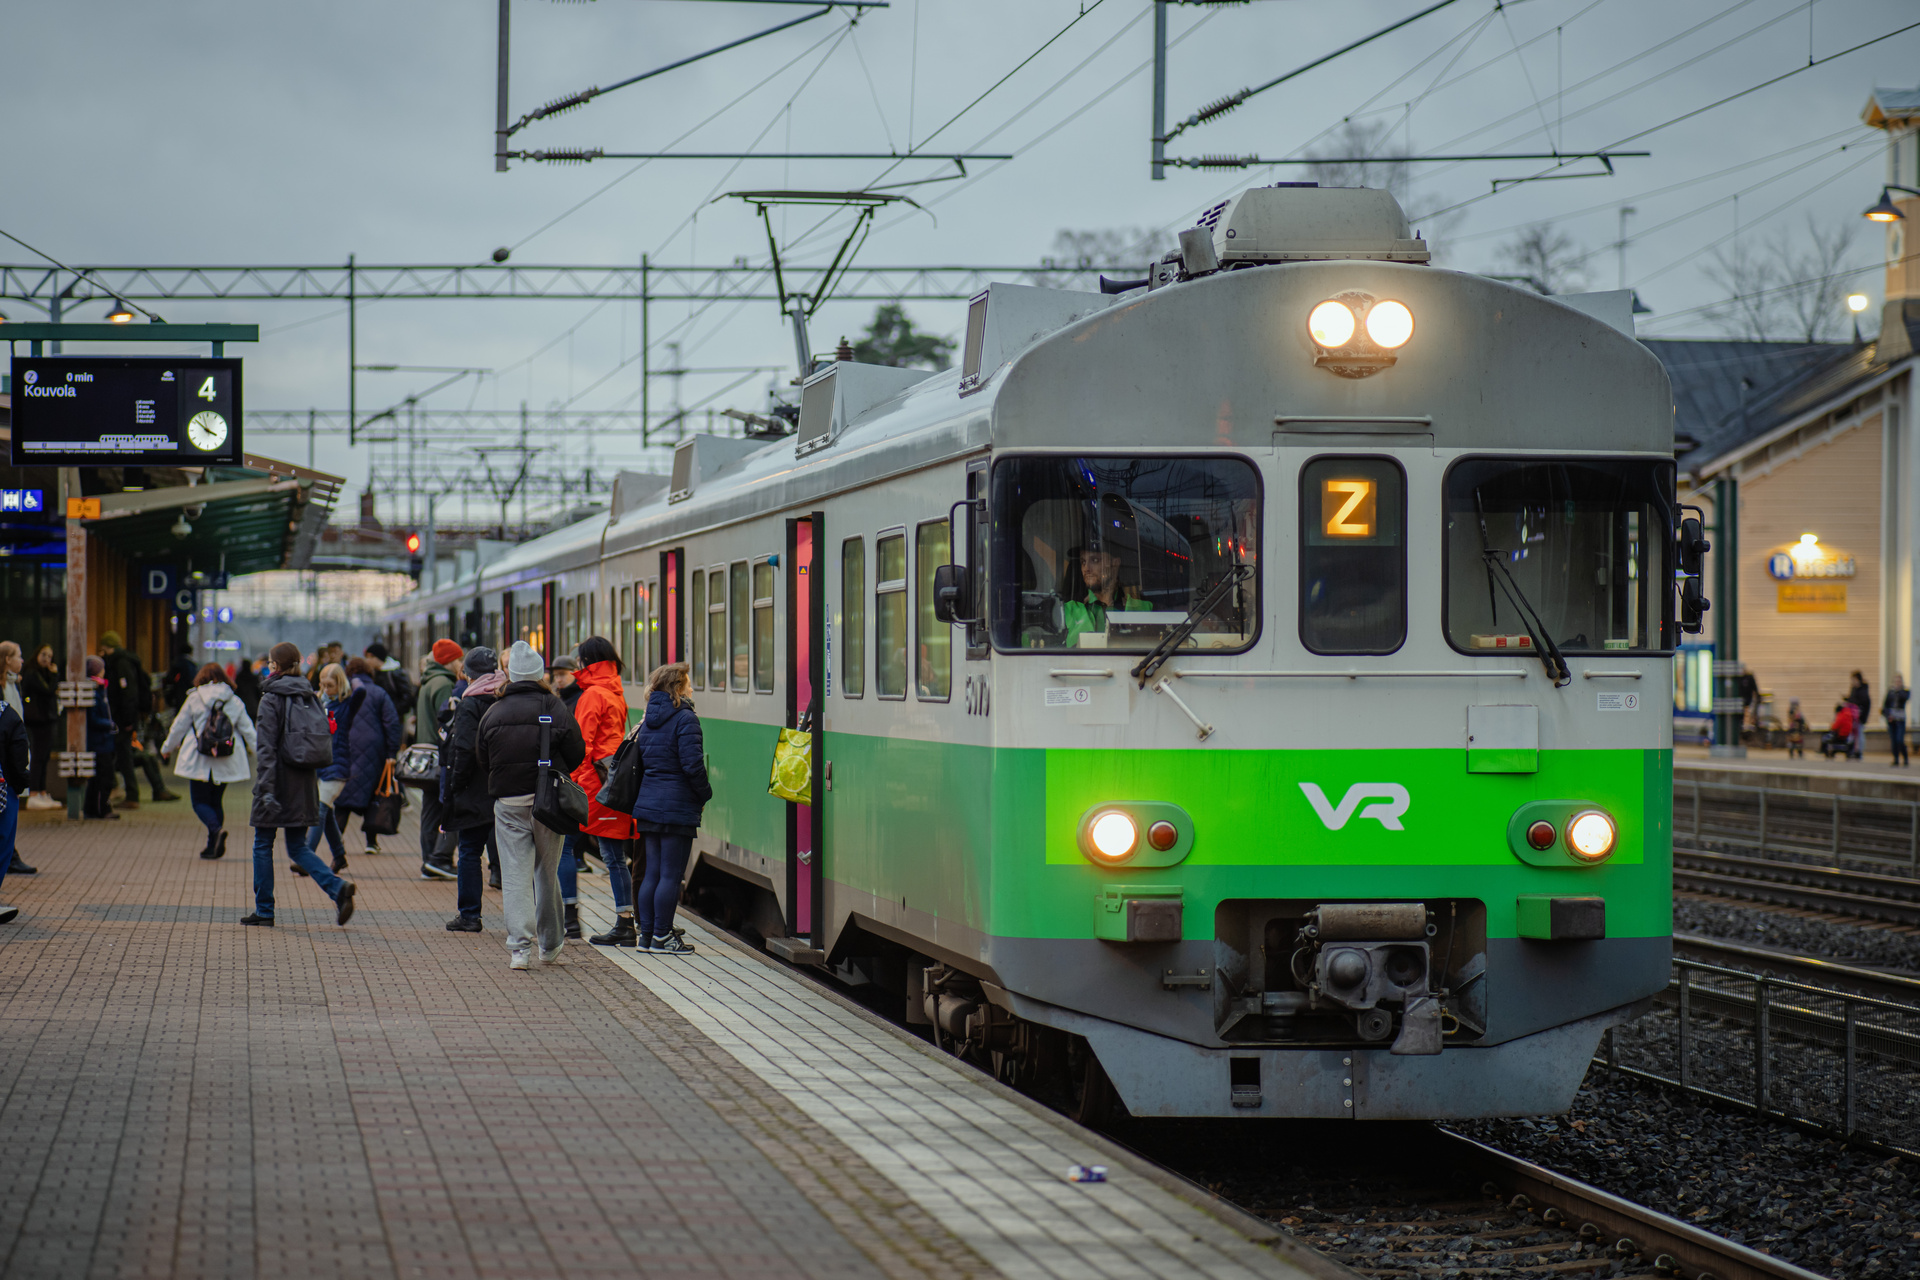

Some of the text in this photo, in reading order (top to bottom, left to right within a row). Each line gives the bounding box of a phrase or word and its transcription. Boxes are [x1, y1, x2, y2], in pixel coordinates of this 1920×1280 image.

[66, 372, 74, 382] 0
[75, 371, 94, 382] min
[24, 384, 77, 398] Kouvola
[198, 376, 217, 402] 4
[1326, 481, 1370, 536] Z
[148, 570, 168, 594] D
[175, 589, 193, 611] C
[1298, 782, 1411, 831] VR
